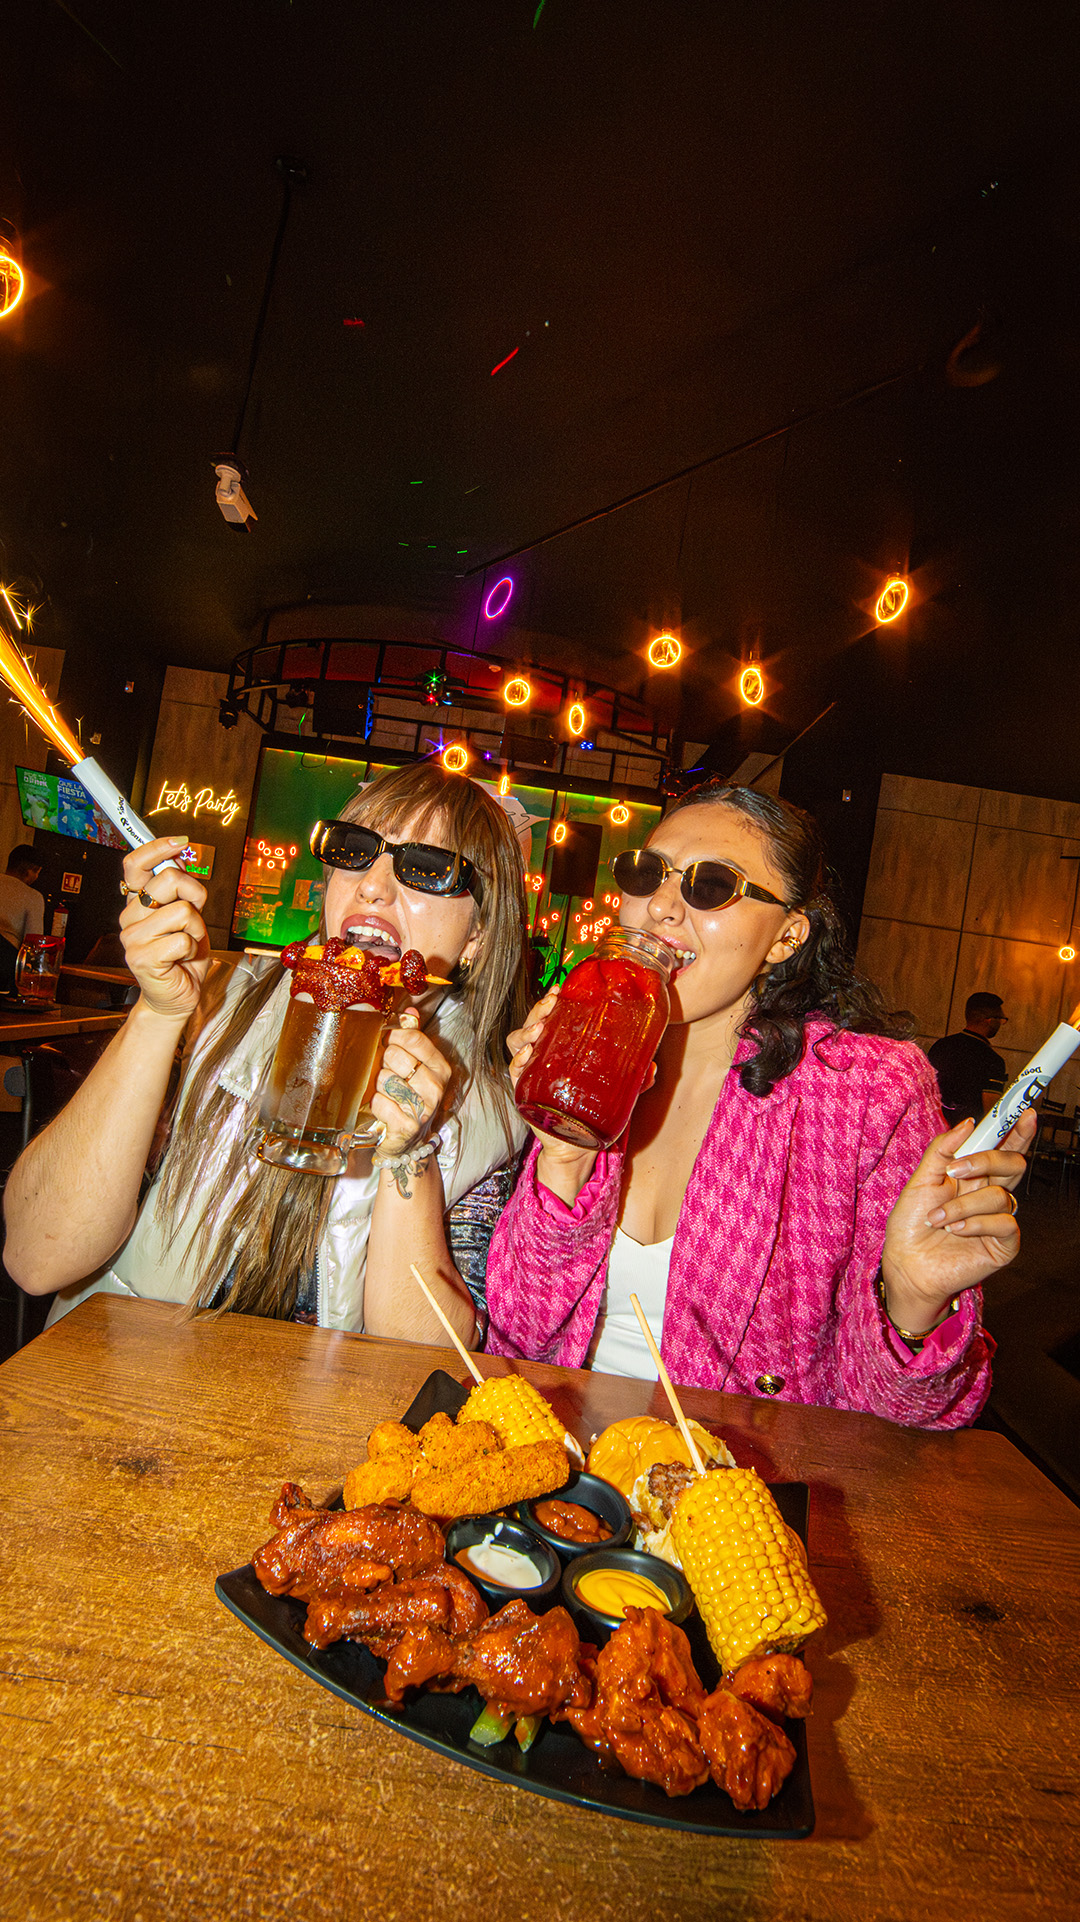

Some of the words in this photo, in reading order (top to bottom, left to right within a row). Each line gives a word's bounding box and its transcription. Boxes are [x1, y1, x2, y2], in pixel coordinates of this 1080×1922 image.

[57, 784, 87, 799] FIESTA
[148, 780, 192, 815] Let's
[194, 787, 241, 827] Party
[185, 863, 208, 876] eken
